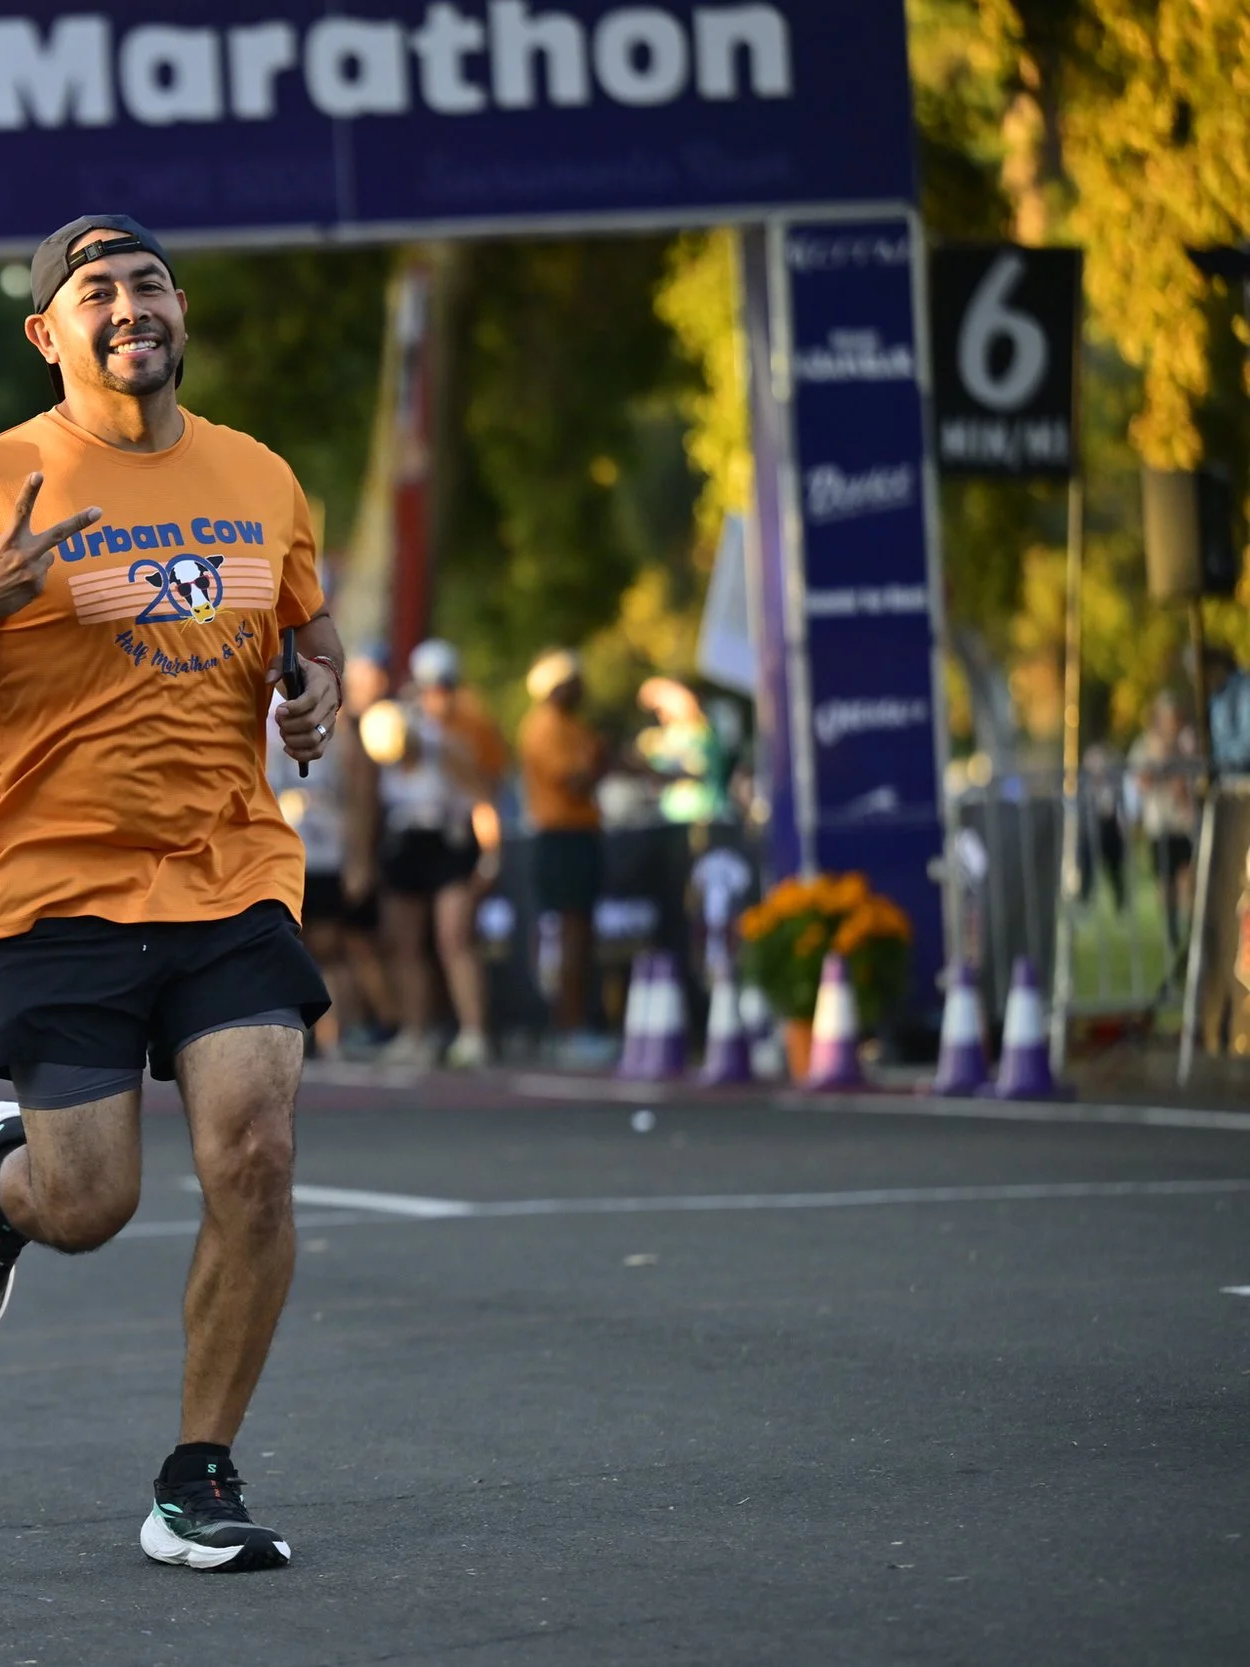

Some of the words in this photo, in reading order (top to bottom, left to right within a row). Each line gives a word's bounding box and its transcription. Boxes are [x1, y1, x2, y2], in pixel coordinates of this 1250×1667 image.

[957, 252, 1048, 410] 6
[58, 522, 185, 563] Urban
[190, 517, 264, 546] Cow
[128, 553, 224, 625] 20
[114, 629, 150, 667] Half
[151, 647, 219, 678] Marathon
[222, 643, 235, 660] &
[235, 619, 254, 648] 5K
[207, 1463, 217, 1473] S
